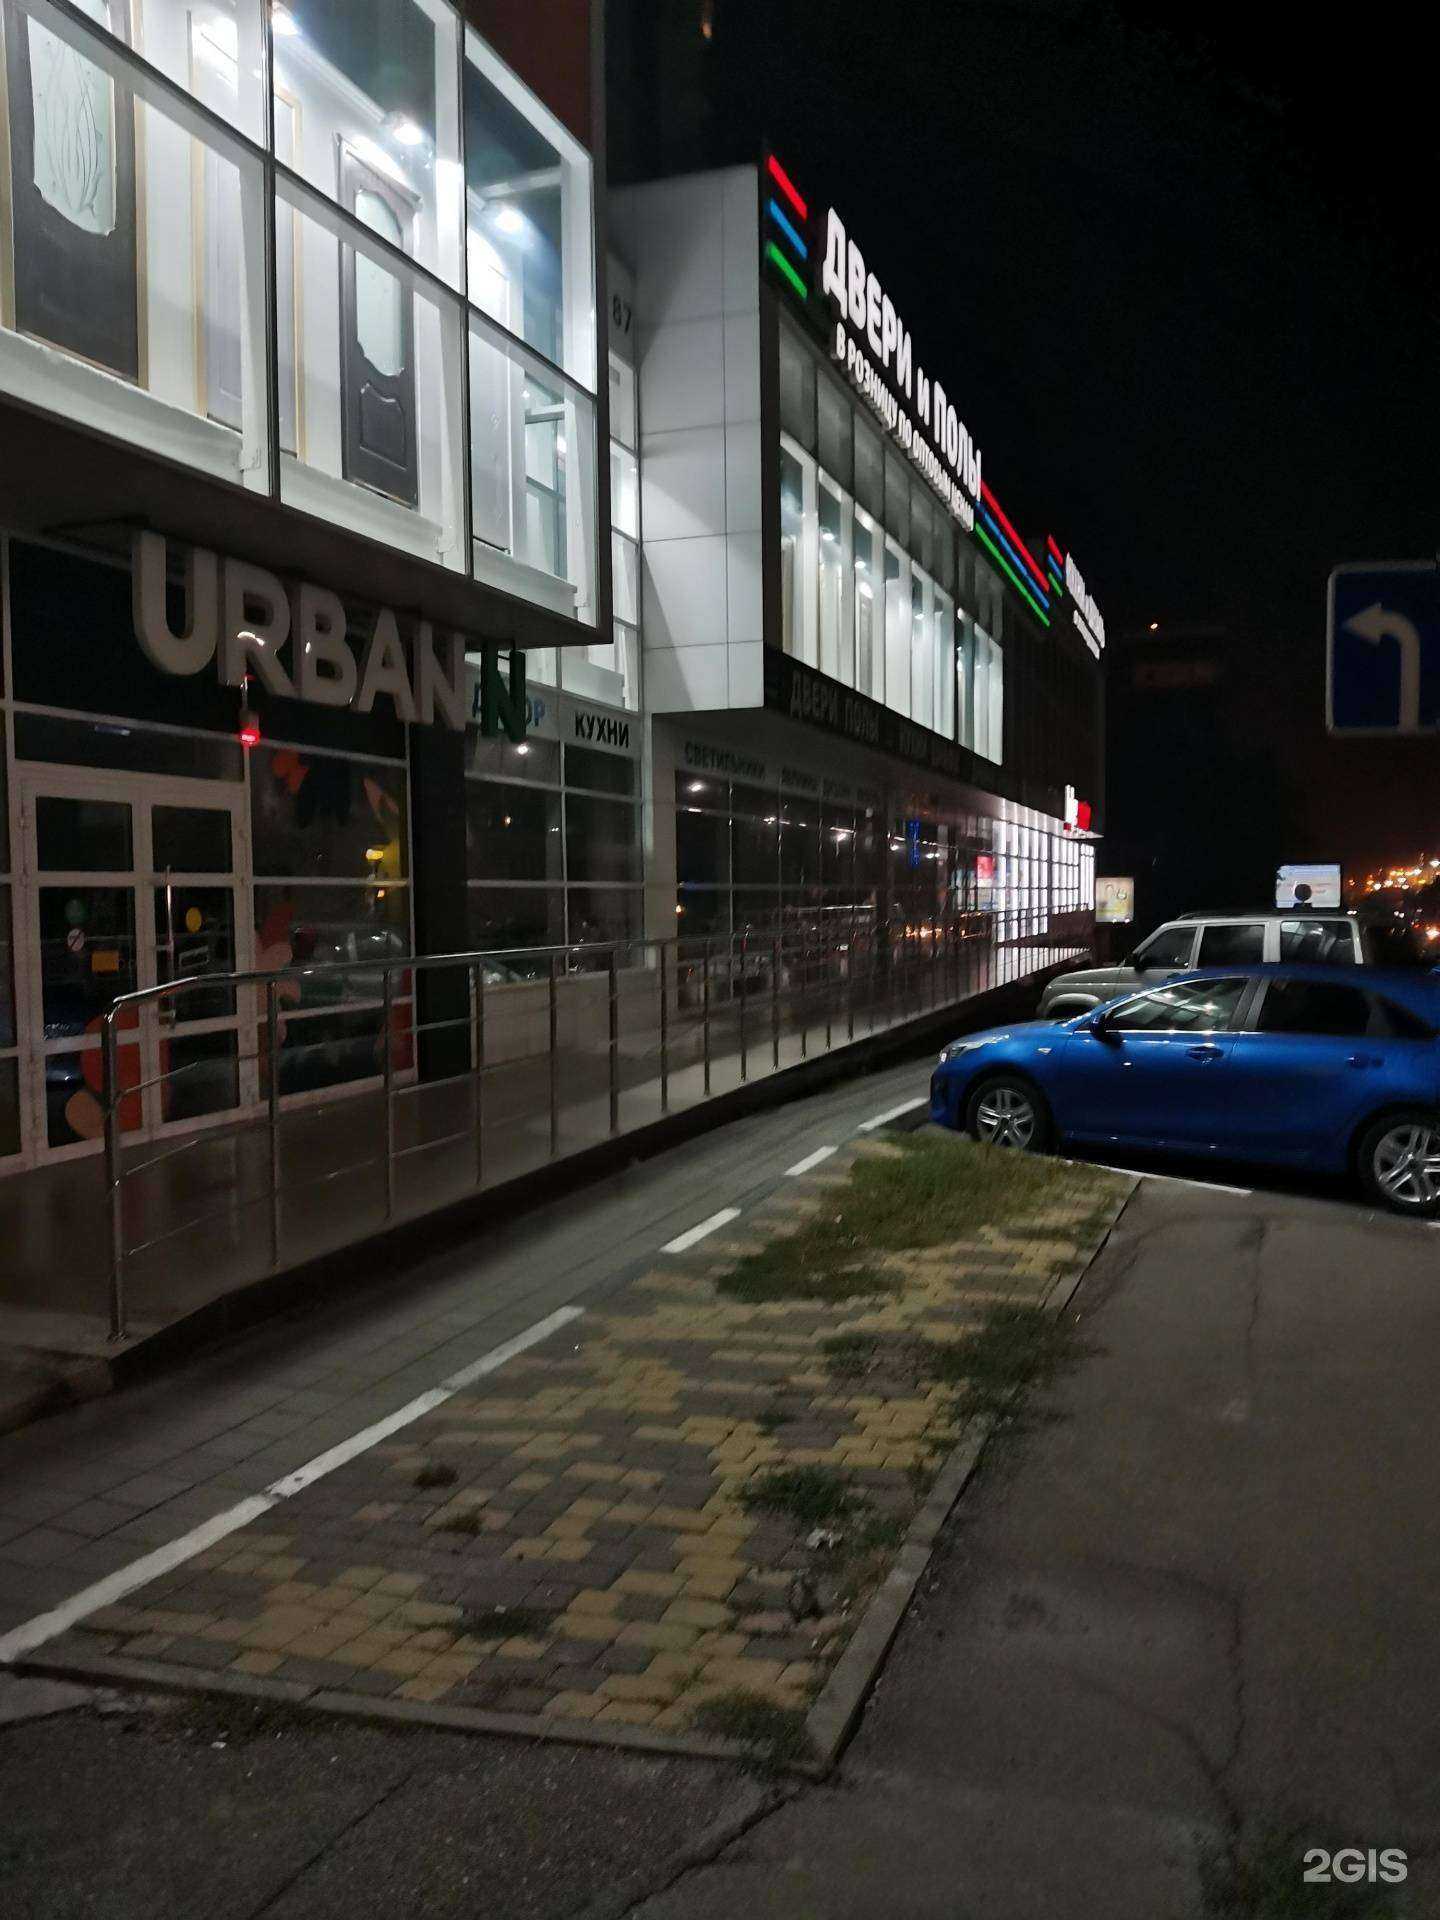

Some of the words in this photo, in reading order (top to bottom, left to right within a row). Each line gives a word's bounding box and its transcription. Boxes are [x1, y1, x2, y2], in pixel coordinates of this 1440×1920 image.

[823, 206, 912, 400] ДВЕРИ
[934, 380, 981, 502] ПОЛЫ
[836, 322, 846, 360] В
[848, 338, 898, 430] РОЗНИЦУ
[132, 528, 468, 731] URBAN
[575, 711, 629, 748] КУХНИ
